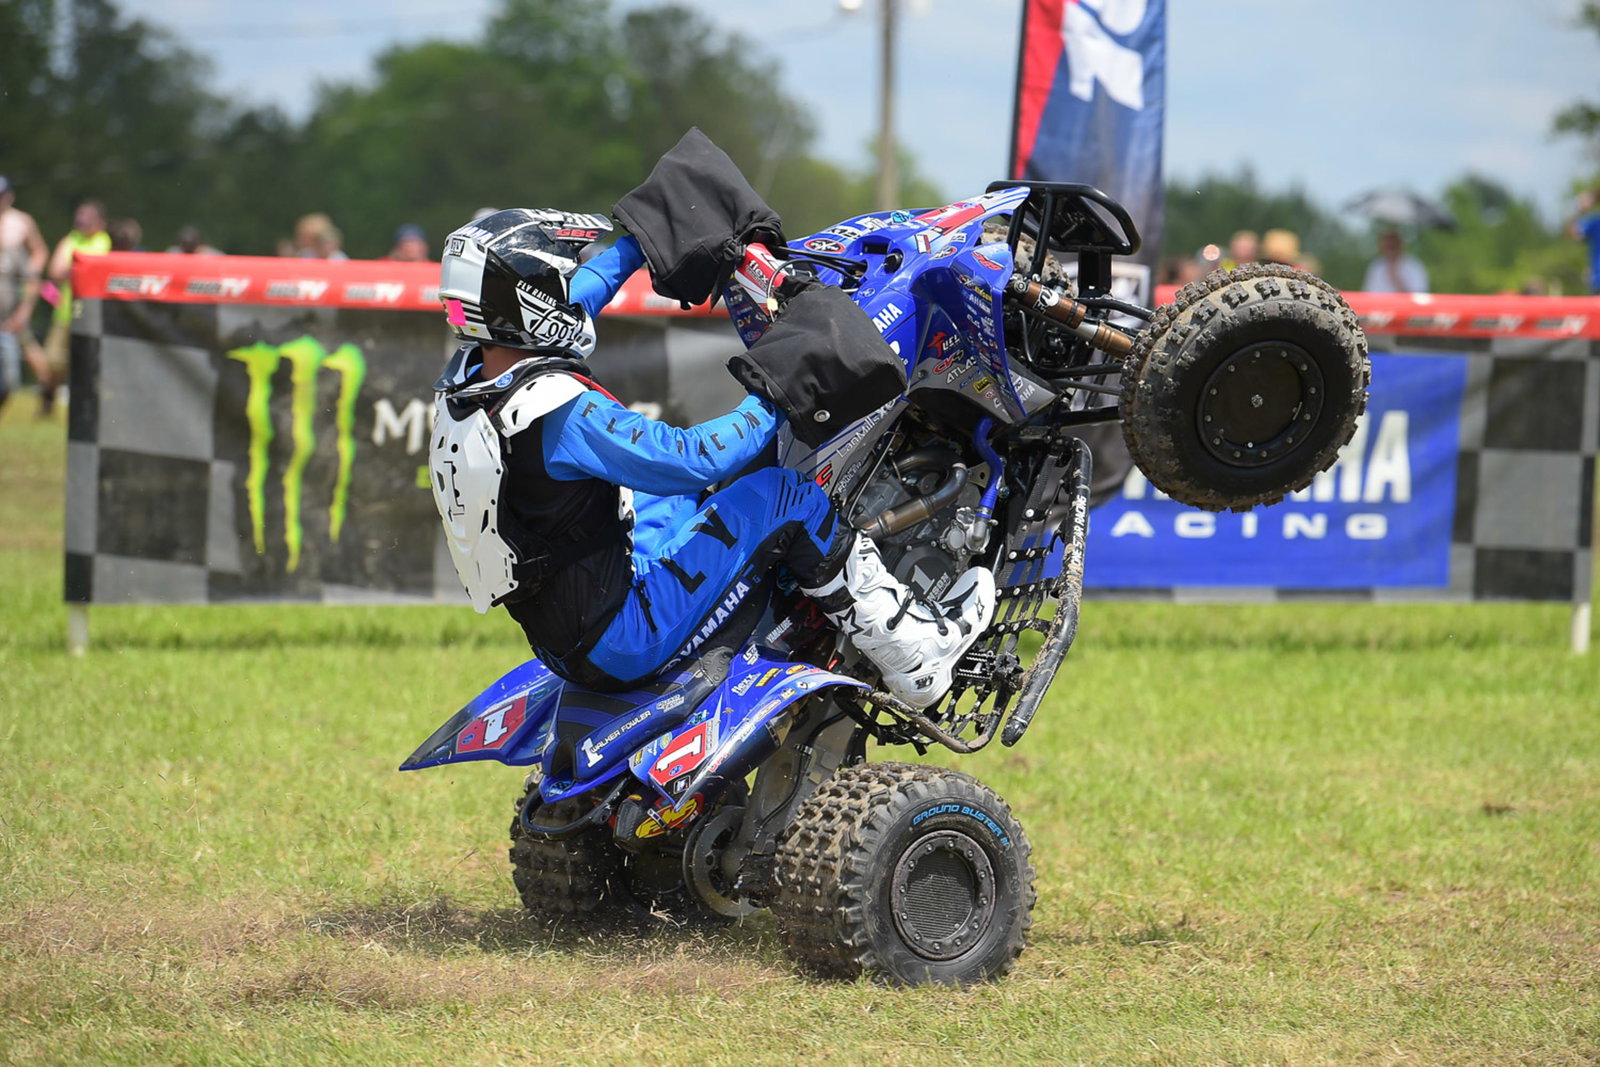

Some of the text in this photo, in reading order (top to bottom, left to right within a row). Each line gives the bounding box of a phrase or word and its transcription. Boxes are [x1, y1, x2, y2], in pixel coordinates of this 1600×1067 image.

[555, 228, 600, 239] GBC
[516, 279, 558, 307] FLY RACING
[582, 401, 645, 445] FLY
[1110, 510, 1388, 540] ACING
[911, 564, 935, 595] 1
[680, 580, 750, 657] YAMAHA
[482, 703, 513, 746] 1
[581, 710, 652, 768] 1 WALKER FOWLER
[655, 733, 703, 772] 1
[912, 804, 960, 826] GROUND
[961, 804, 1003, 837] BUSTER
